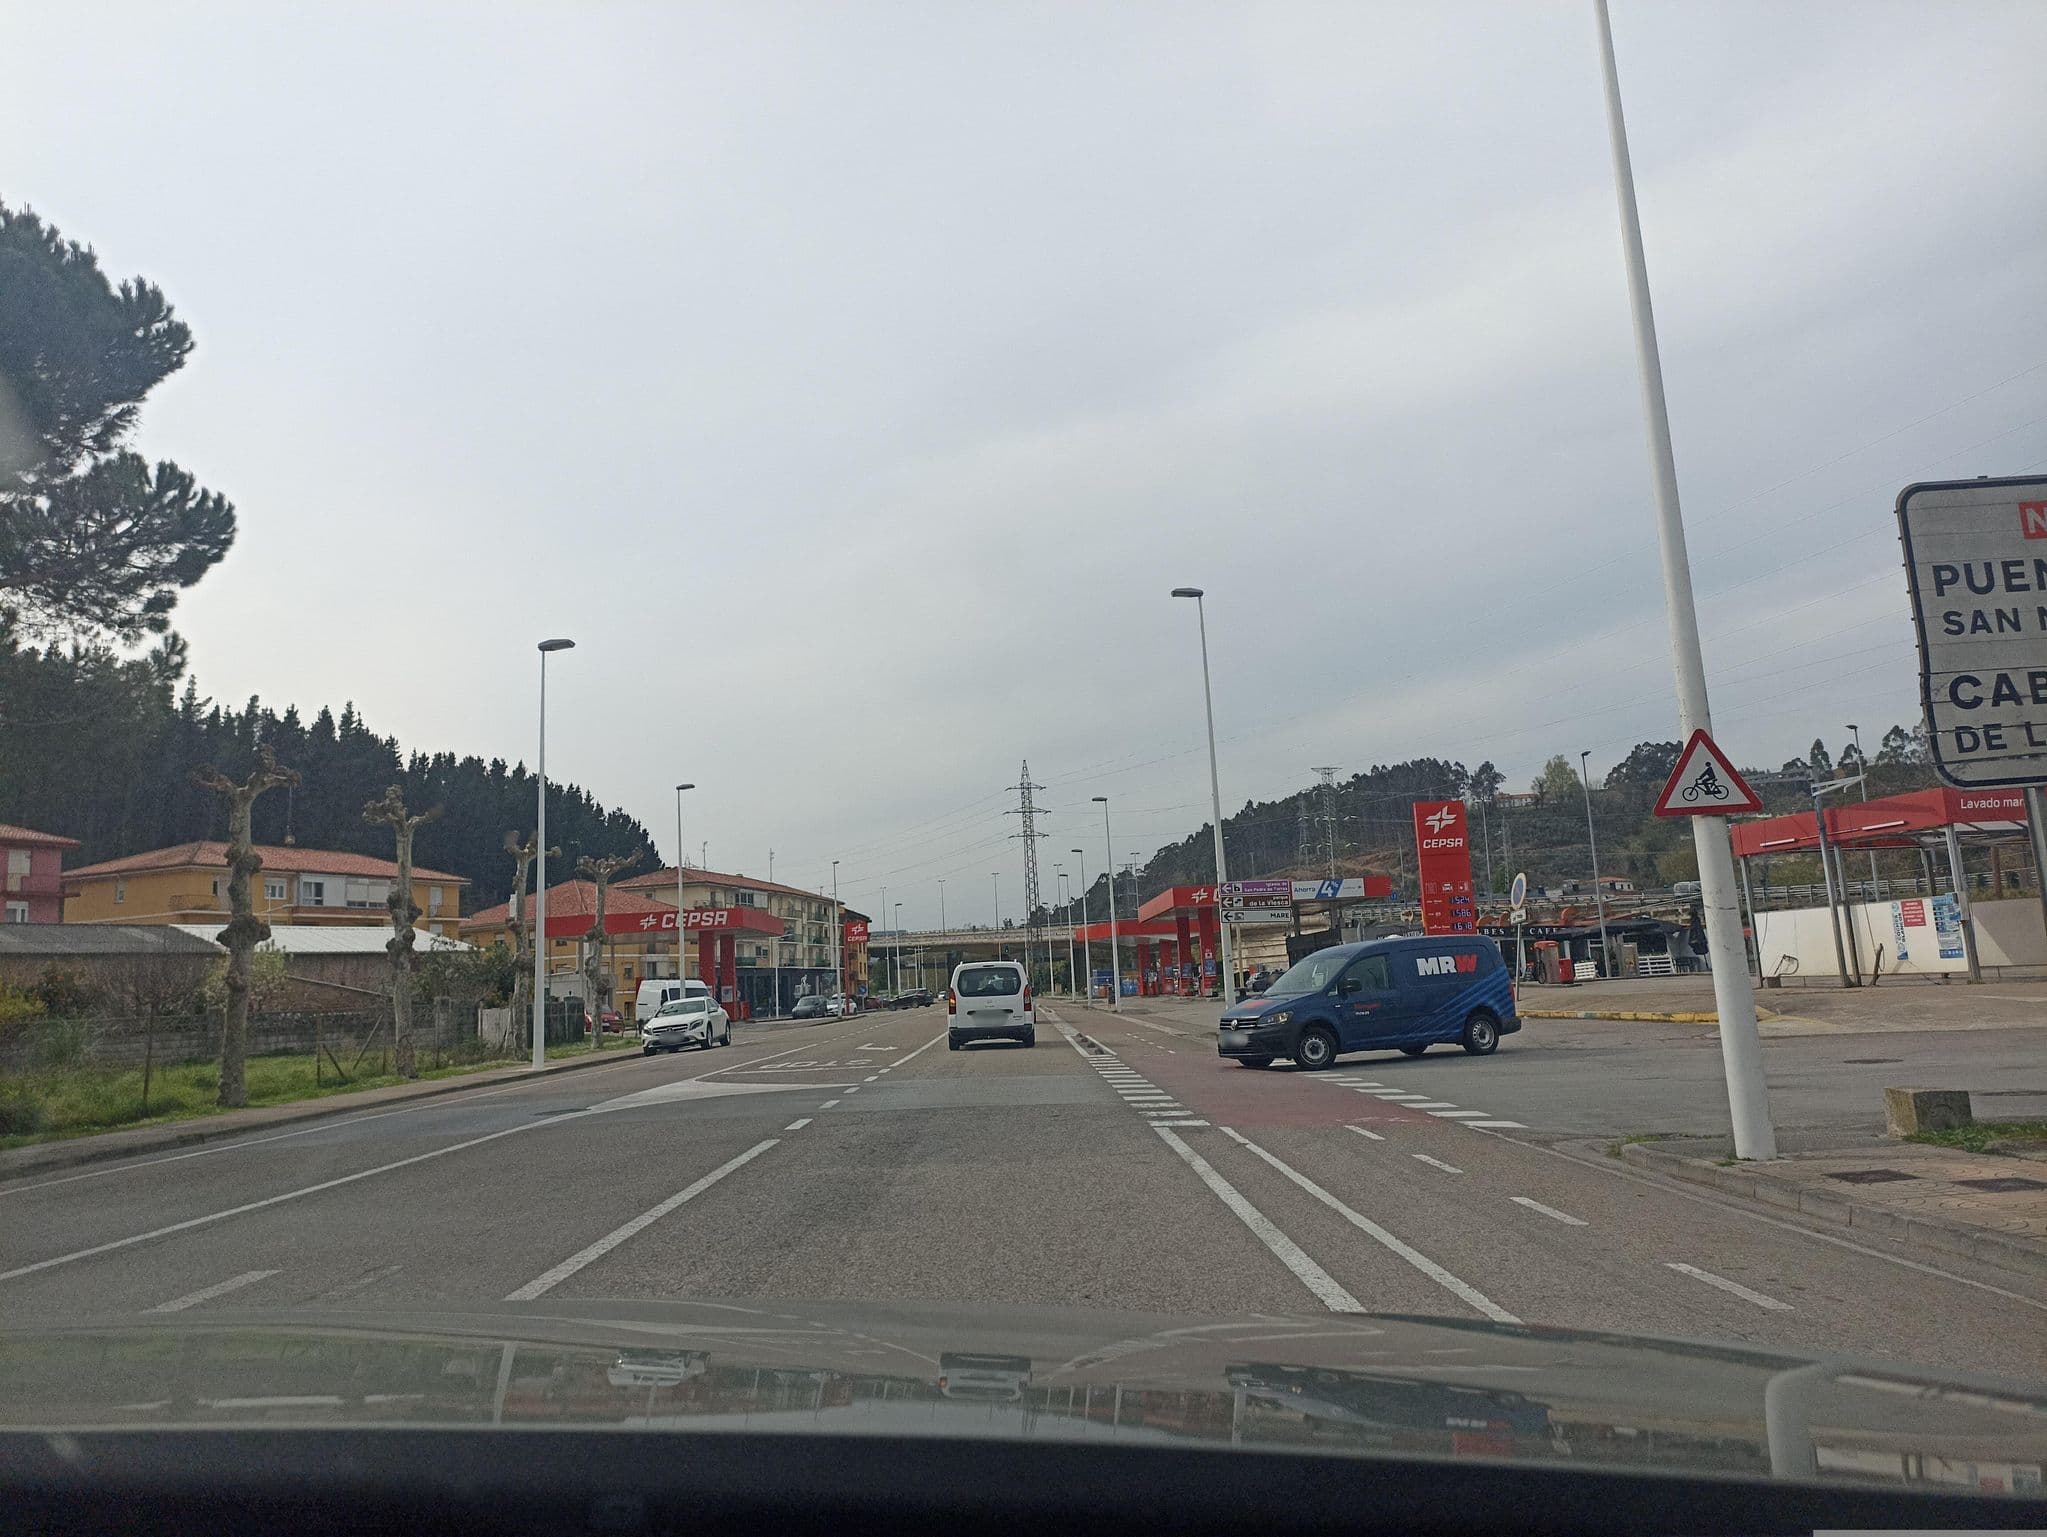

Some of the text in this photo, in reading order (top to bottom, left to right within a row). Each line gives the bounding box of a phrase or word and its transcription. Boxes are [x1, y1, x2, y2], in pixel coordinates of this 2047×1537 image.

[1943, 607, 2022, 636] SAN
[1955, 723, 2007, 754] DE
[1960, 797, 2001, 809] Lavado
[1423, 838, 1464, 849] CEPSA
[661, 911, 728, 929] CEPSA
[1416, 954, 1478, 976] MRW
